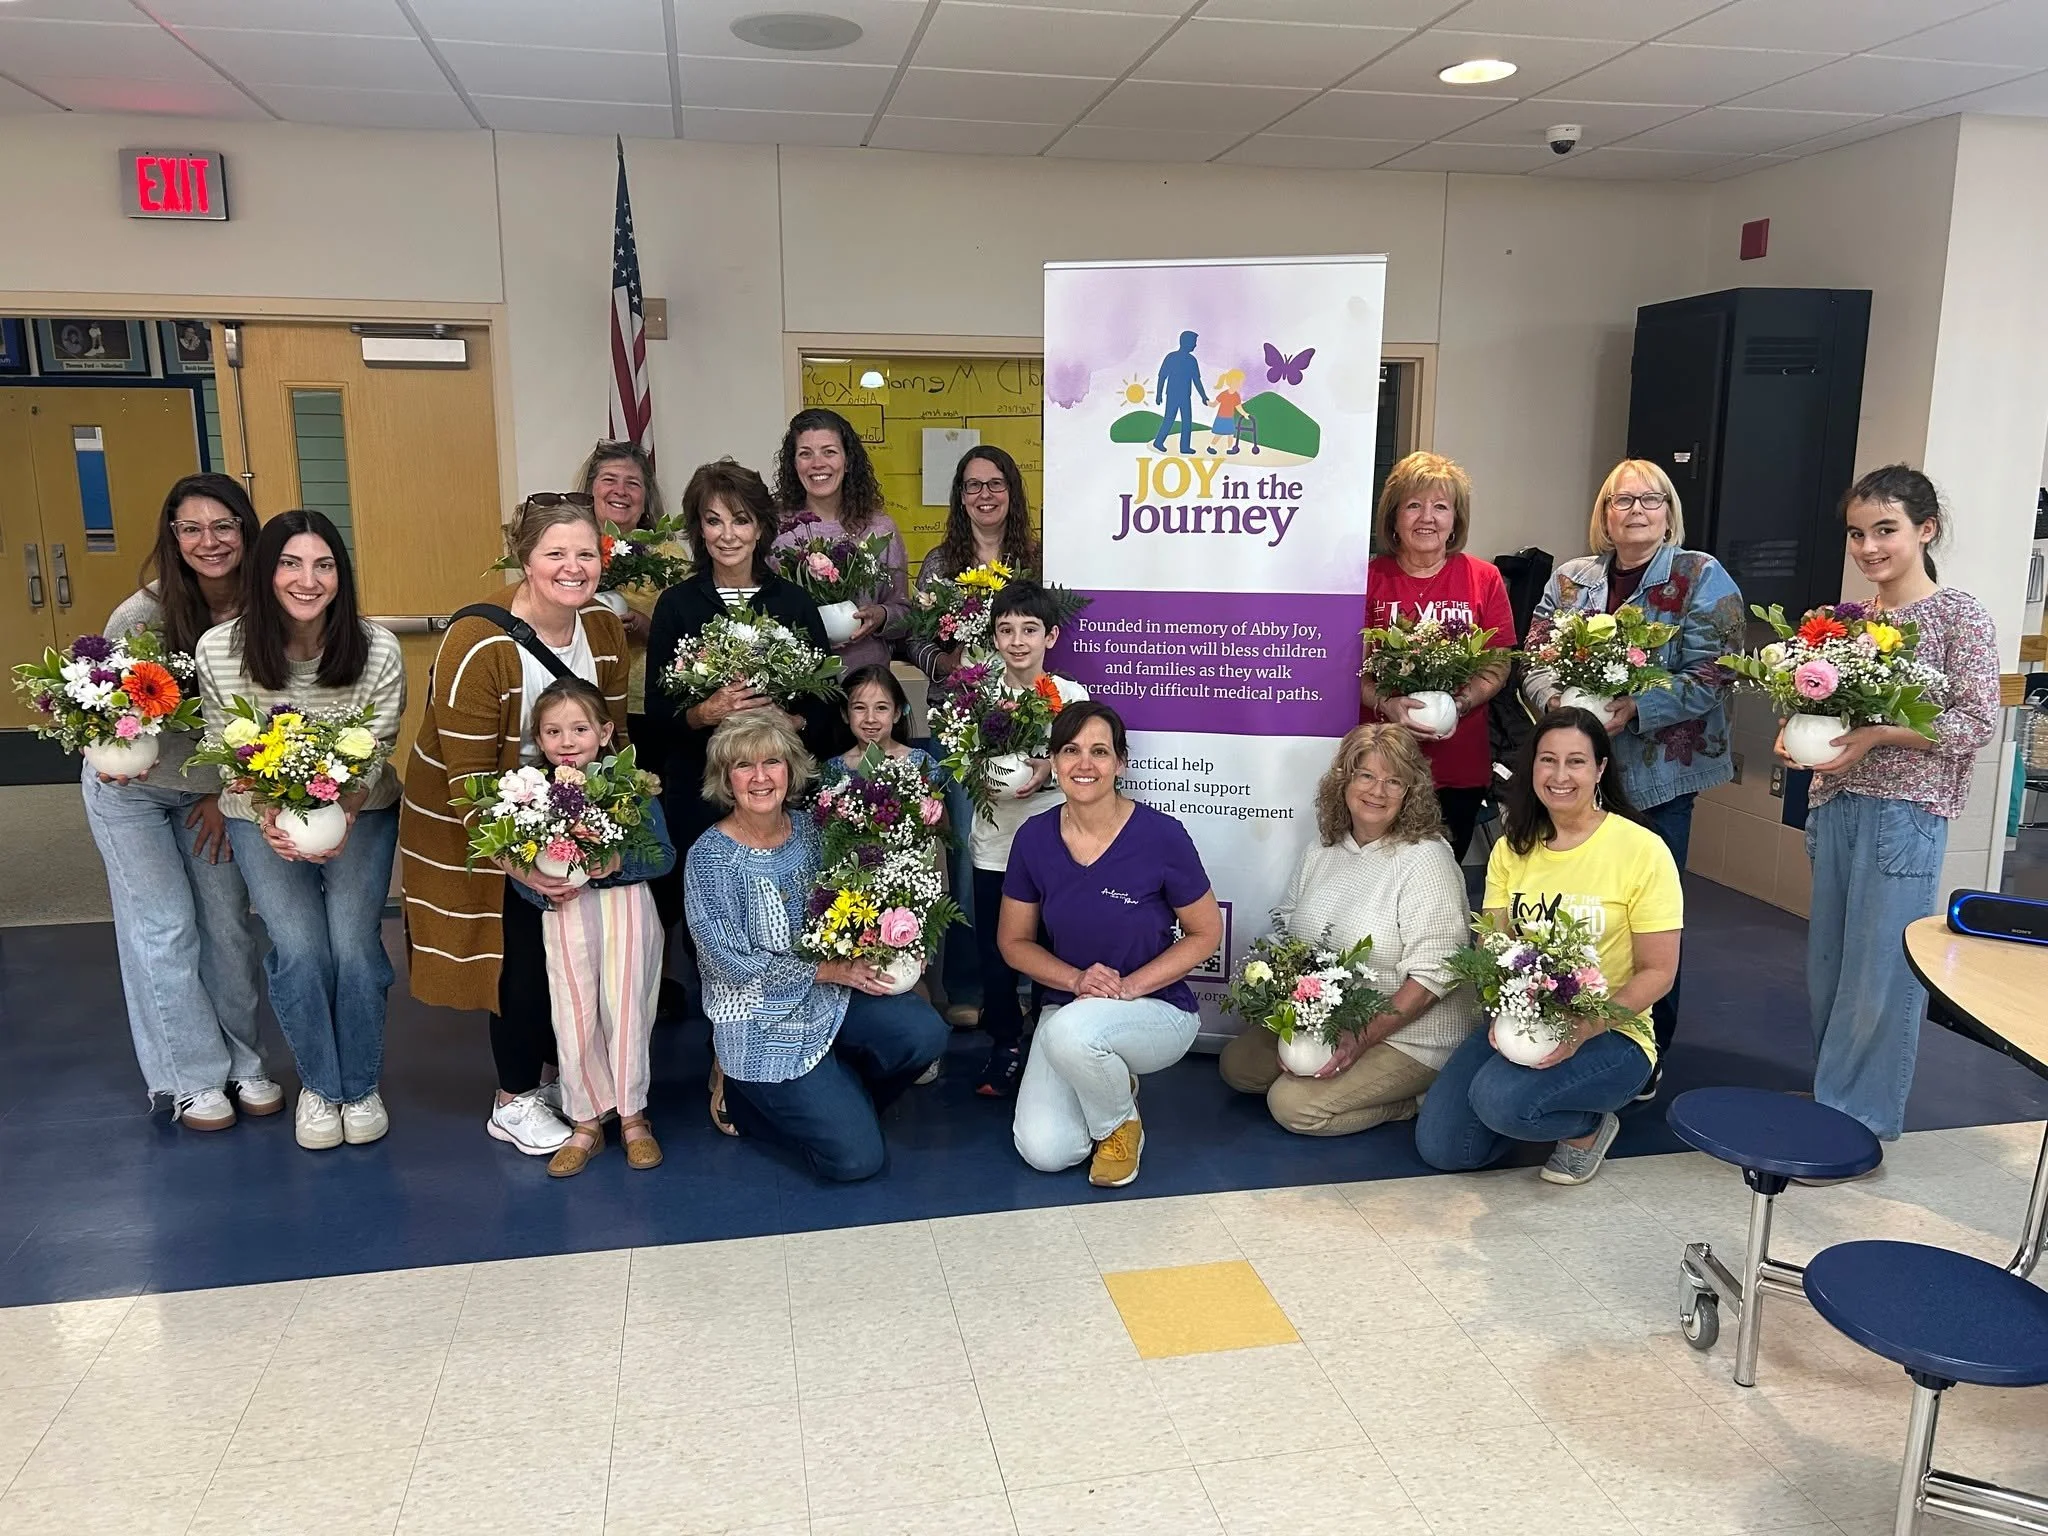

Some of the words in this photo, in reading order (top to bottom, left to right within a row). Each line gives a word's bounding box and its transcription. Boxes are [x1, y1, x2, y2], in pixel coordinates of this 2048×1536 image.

[136, 157, 209, 213] EXIT
[1134, 457, 1226, 505] JOY
[1222, 475, 1249, 500] in
[1257, 473, 1303, 500] the
[1112, 494, 1299, 547] Journey
[1435, 600, 1449, 609] OF
[1451, 600, 1470, 610] THE
[1079, 618, 1142, 634] Founded
[1146, 618, 1160, 634] in
[1164, 622, 1228, 638] memory
[1231, 620, 1247, 636] of
[1250, 621, 1289, 640] Abby
[1291, 622, 1322, 641] Joy,
[1072, 638, 1101, 654] this
[1104, 639, 1186, 655] foundation
[1190, 640, 1218, 656] will
[1221, 642, 1259, 657] bless
[1263, 643, 1327, 659] children
[1105, 660, 1132, 675] and
[1135, 661, 1195, 677] families
[1199, 666, 1215, 677] as
[1218, 663, 1252, 682] they
[1255, 664, 1292, 679] walk
[1082, 681, 1147, 699] credibly
[1150, 681, 1210, 698] difficult
[1213, 683, 1273, 700] medical
[1276, 686, 1323, 704] paths.
[1126, 756, 1178, 770] ractical
[1182, 757, 1214, 775] help
[1193, 782, 1251, 799] support
[1179, 802, 1294, 820] encouragement
[1581, 894, 1602, 906] THE
